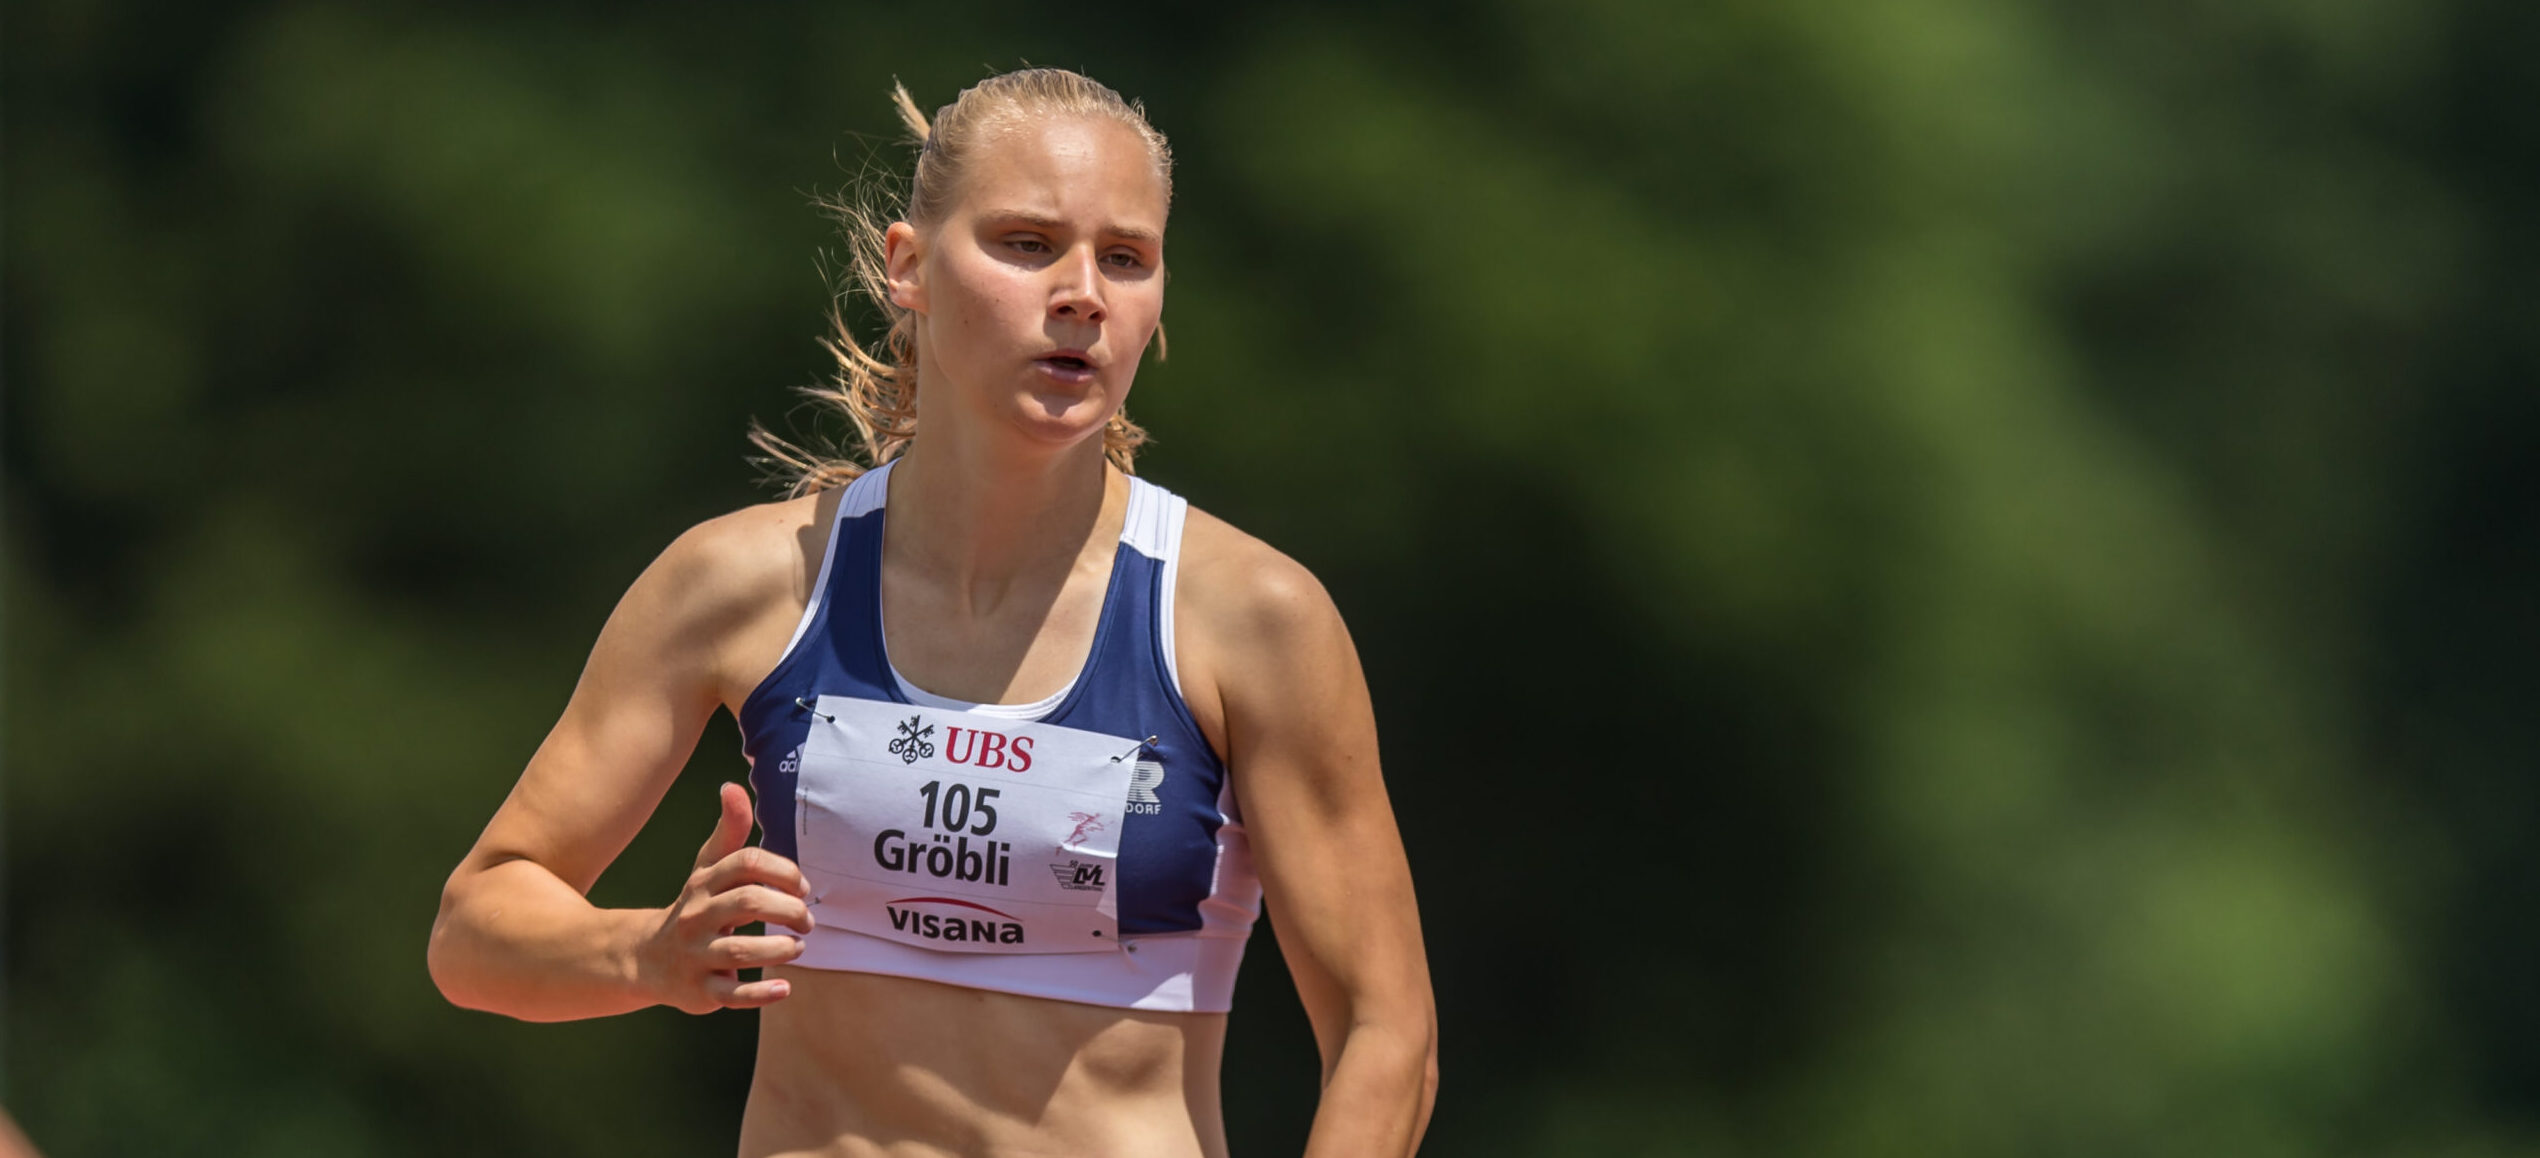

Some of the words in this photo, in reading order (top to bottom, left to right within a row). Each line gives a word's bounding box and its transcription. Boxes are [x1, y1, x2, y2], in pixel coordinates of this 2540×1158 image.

[945, 726, 1034, 773] UBS
[919, 780, 1001, 836] 105
[873, 829, 1011, 887] Gröbli
